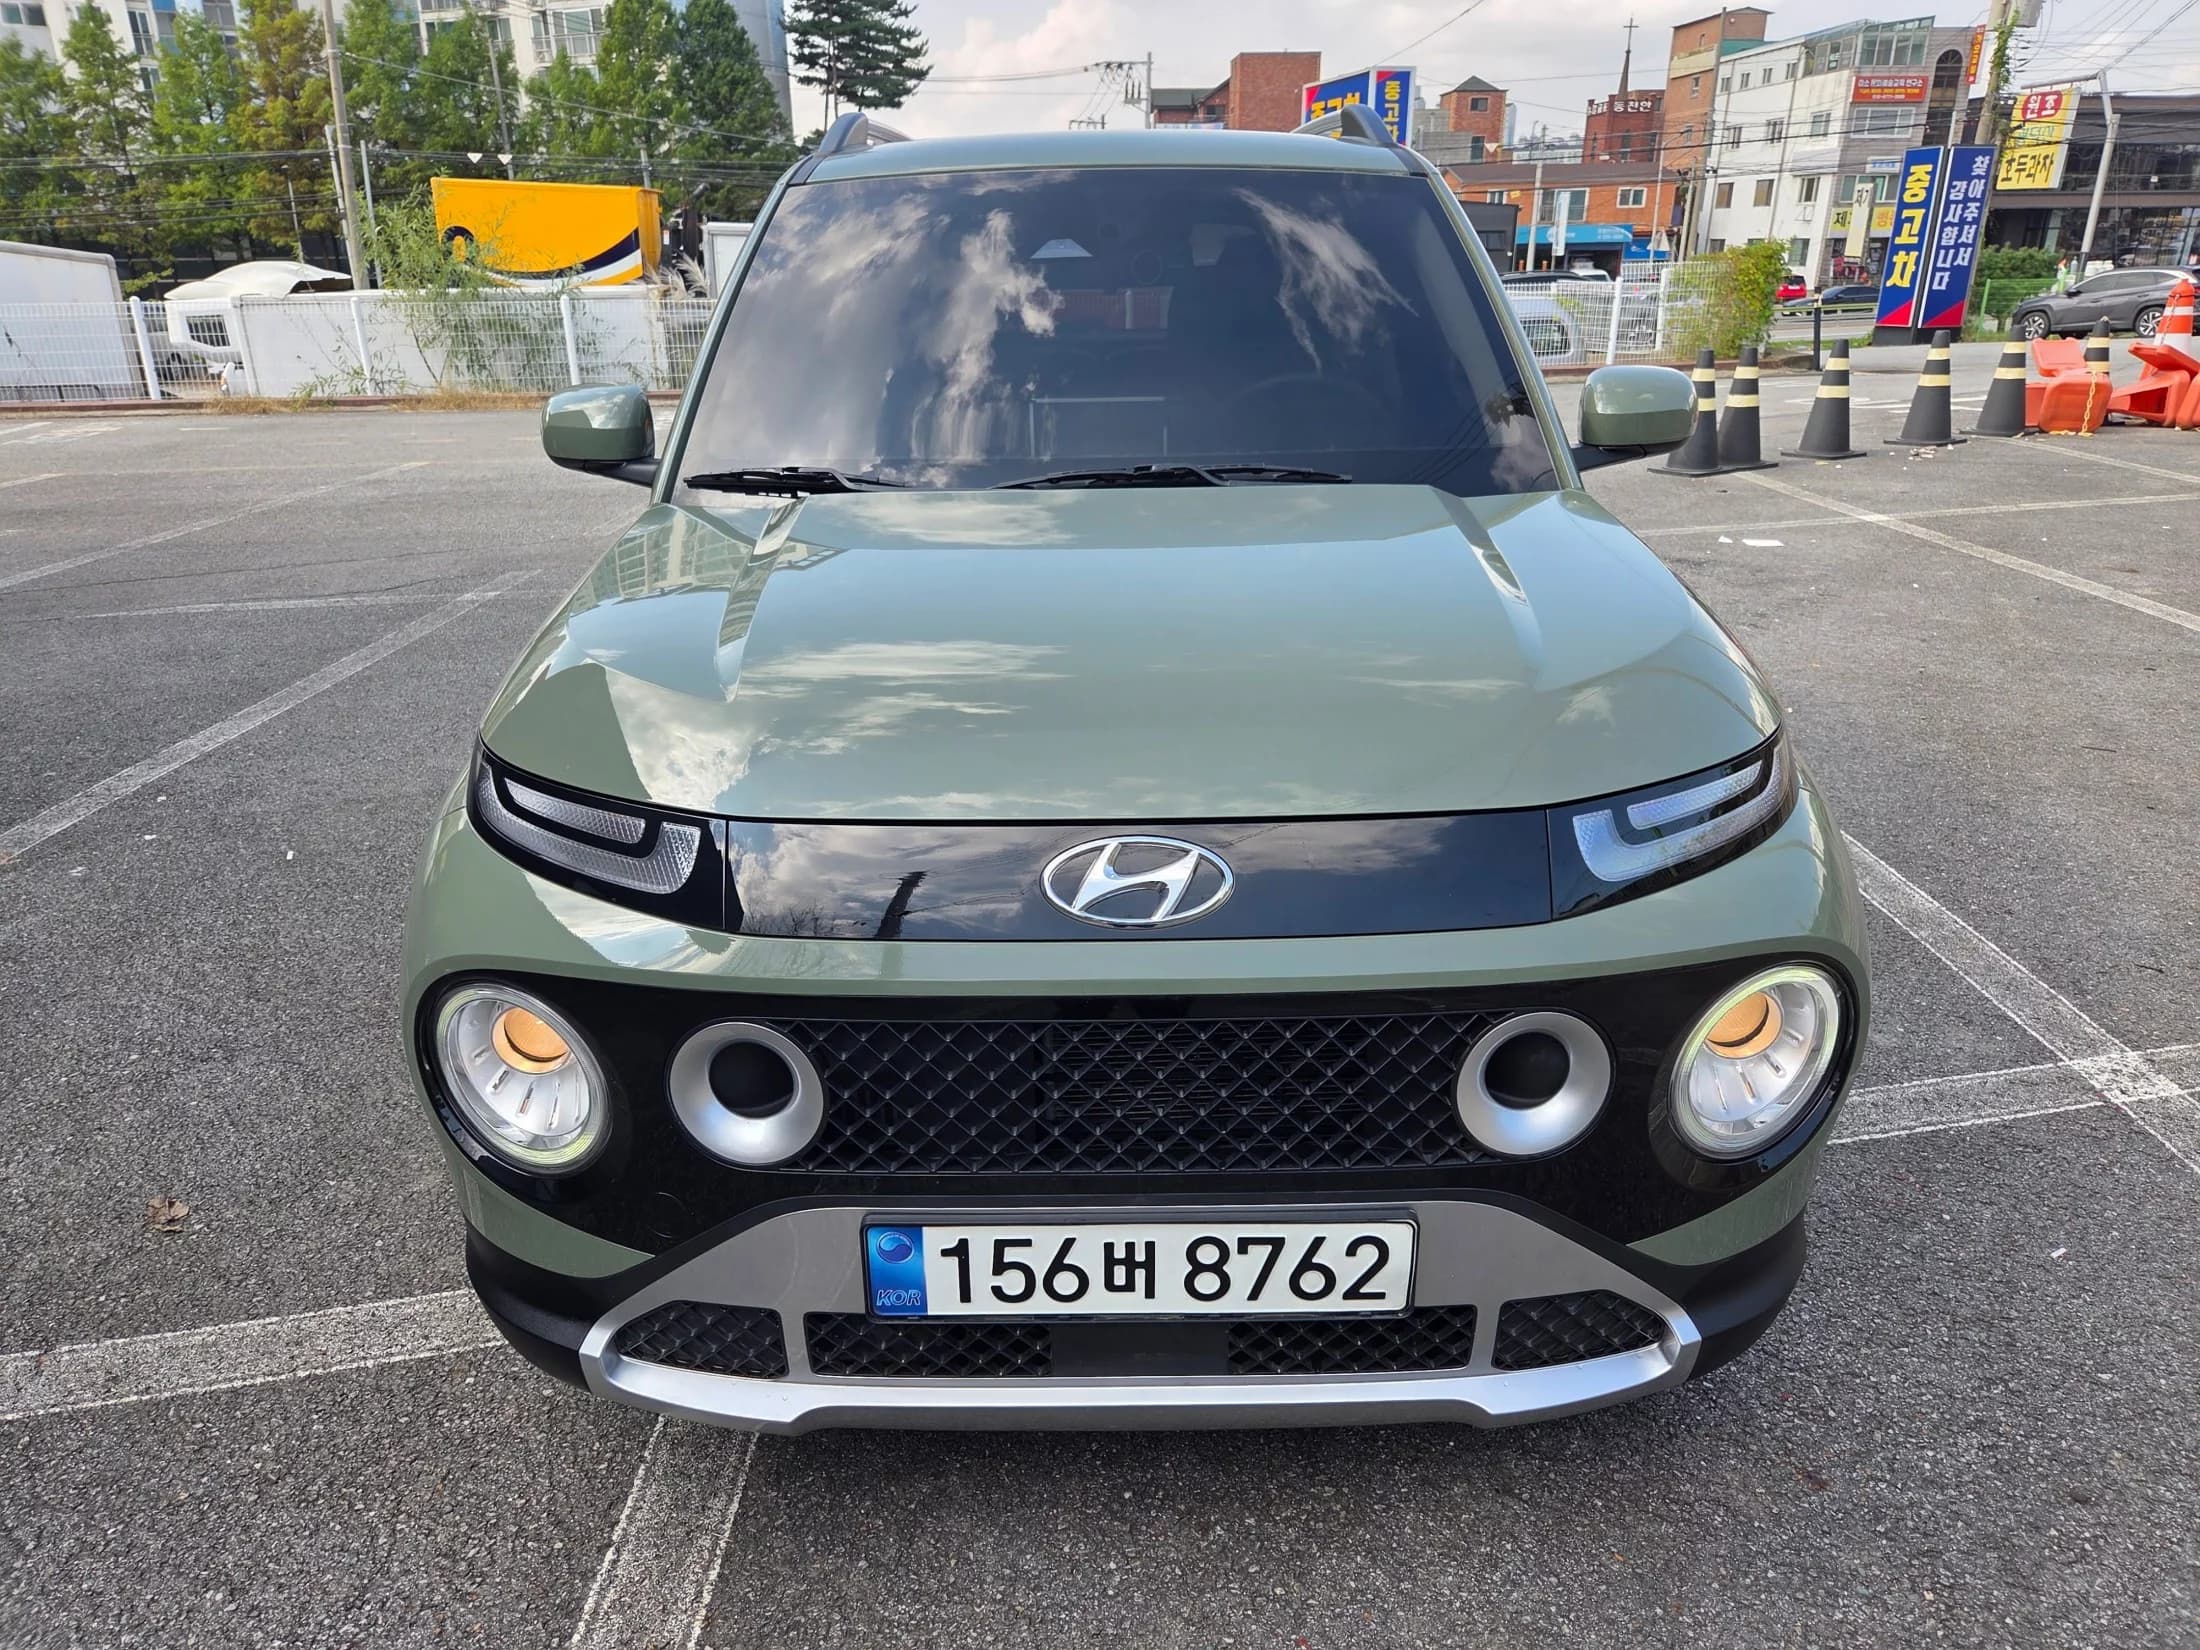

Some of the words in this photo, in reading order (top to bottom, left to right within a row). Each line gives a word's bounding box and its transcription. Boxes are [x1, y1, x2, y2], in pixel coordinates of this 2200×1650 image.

[2025, 95, 2059, 119] 원조
[2001, 152, 2055, 184] 호두과자
[1886, 163, 1934, 288] 중고차
[1932, 180, 1968, 291] 감사합니다
[1953, 155, 1991, 267] 찾아주셔서
[876, 1289, 921, 1306] KOR
[940, 1237, 1156, 1303] 156버
[1184, 1235, 1390, 1302] 8762
